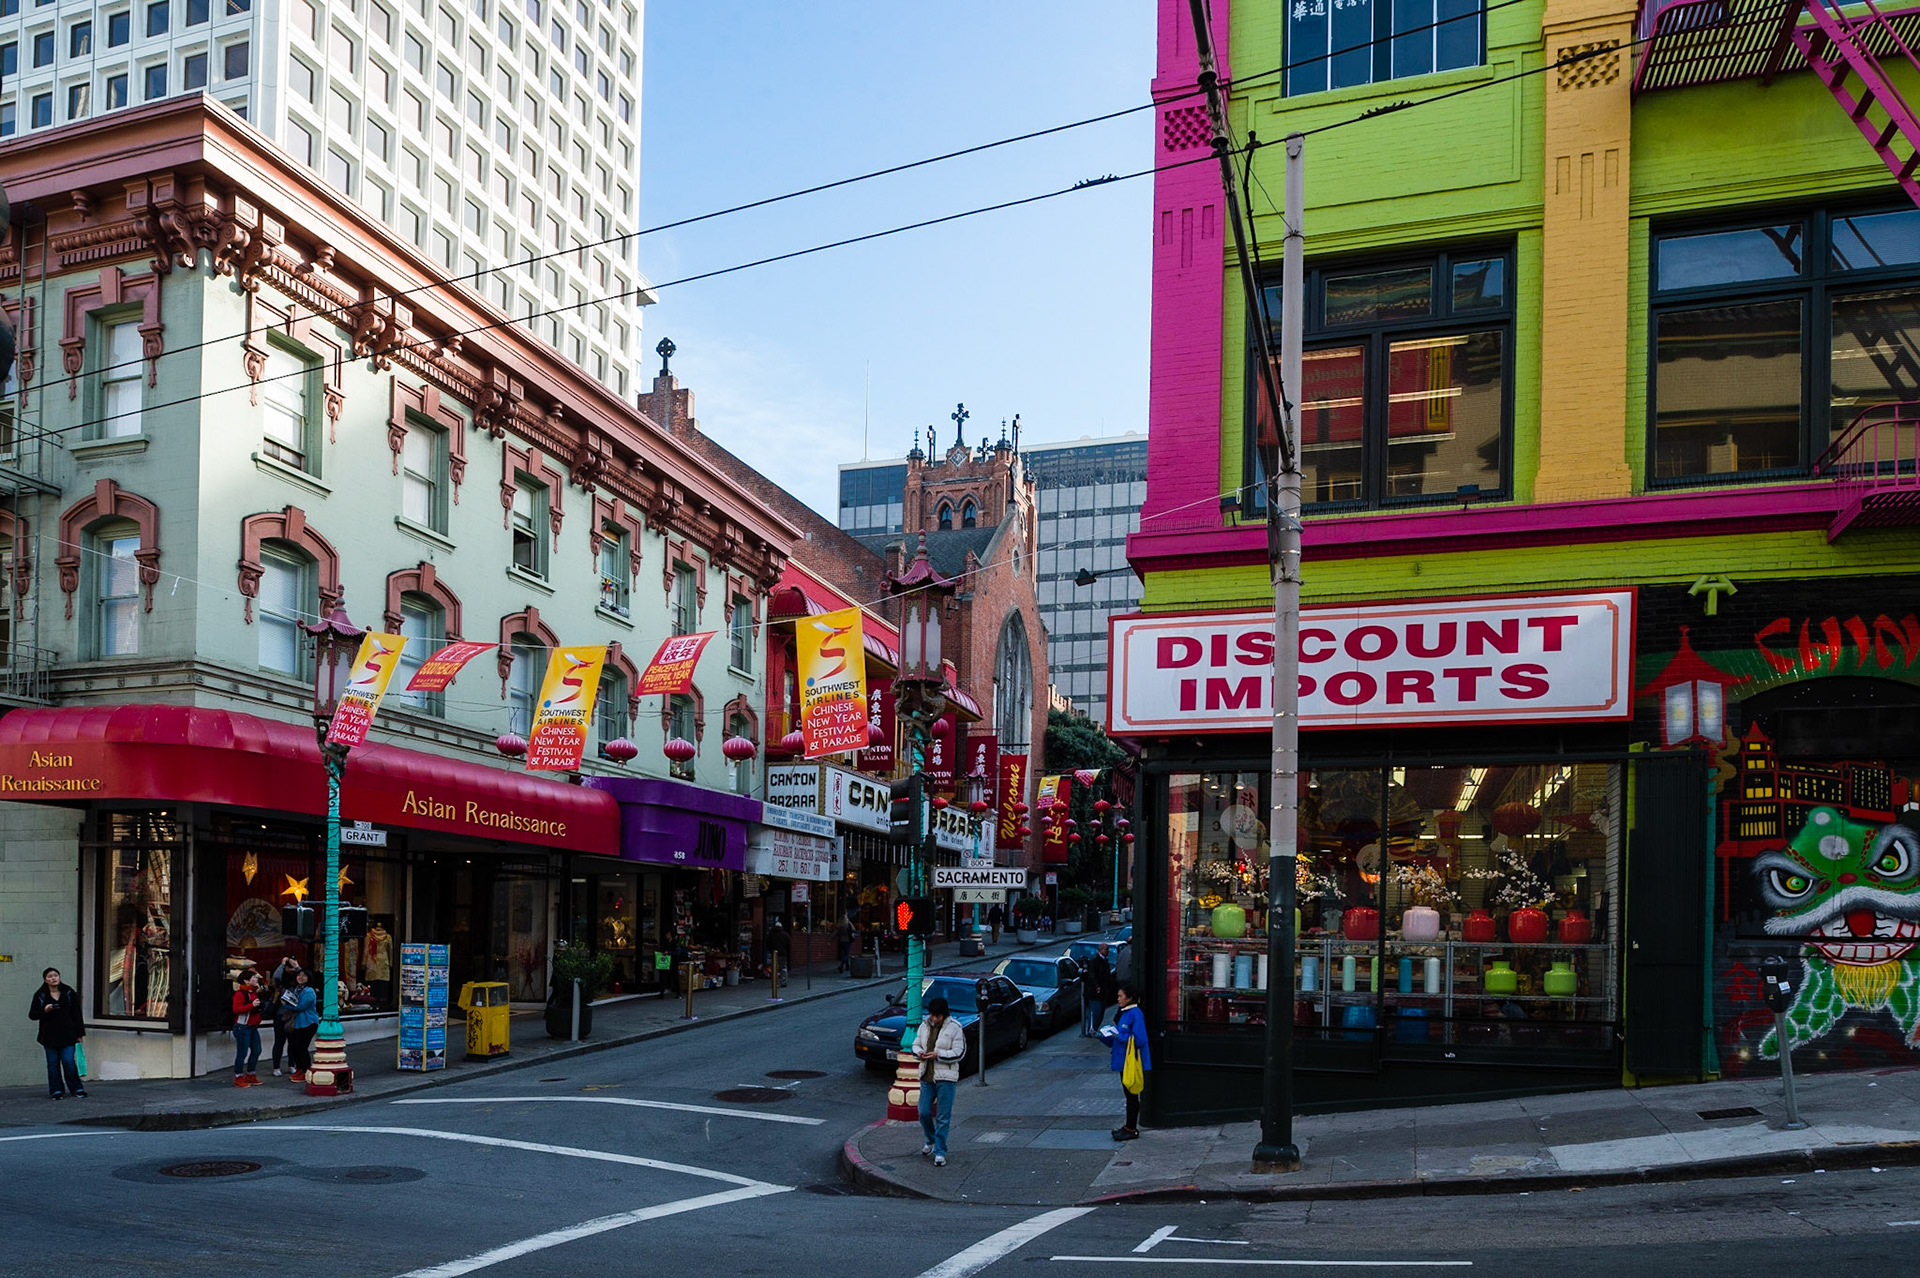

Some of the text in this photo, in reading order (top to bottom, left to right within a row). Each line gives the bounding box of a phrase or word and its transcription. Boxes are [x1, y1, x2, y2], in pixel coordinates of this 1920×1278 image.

[1157, 615, 1578, 669] DISCOUNT
[680, 659, 694, 670] AND
[672, 669, 691, 680] YEAR
[804, 680, 861, 697] SOUTHWEST
[805, 691, 860, 707] AIRLINES
[539, 709, 587, 717] SOUTHWEST
[812, 702, 854, 716] CHINESE
[350, 714, 369, 726] YEAR
[807, 716, 831, 729] NEW
[834, 711, 862, 725] YEAR
[541, 726, 576, 736] CHINESE
[813, 725, 857, 739] FESTIVAL
[534, 736, 580, 746] NEW YEAR
[809, 734, 862, 750] & PARADE
[536, 746, 573, 756] FESTIVAL
[29, 750, 73, 768] Asian
[530, 757, 576, 766] & PARADE
[1, 774, 101, 792] Renaissance
[770, 773, 817, 787] CANTON
[848, 780, 888, 814] CAN
[1000, 764, 1021, 839] Welcome
[402, 790, 568, 838] Asian Renaissance
[346, 831, 380, 842] GRANT
[693, 820, 727, 862] JUNO
[937, 871, 1024, 884] SACRAMENTO
[960, 891, 1000, 901] 唐人街
